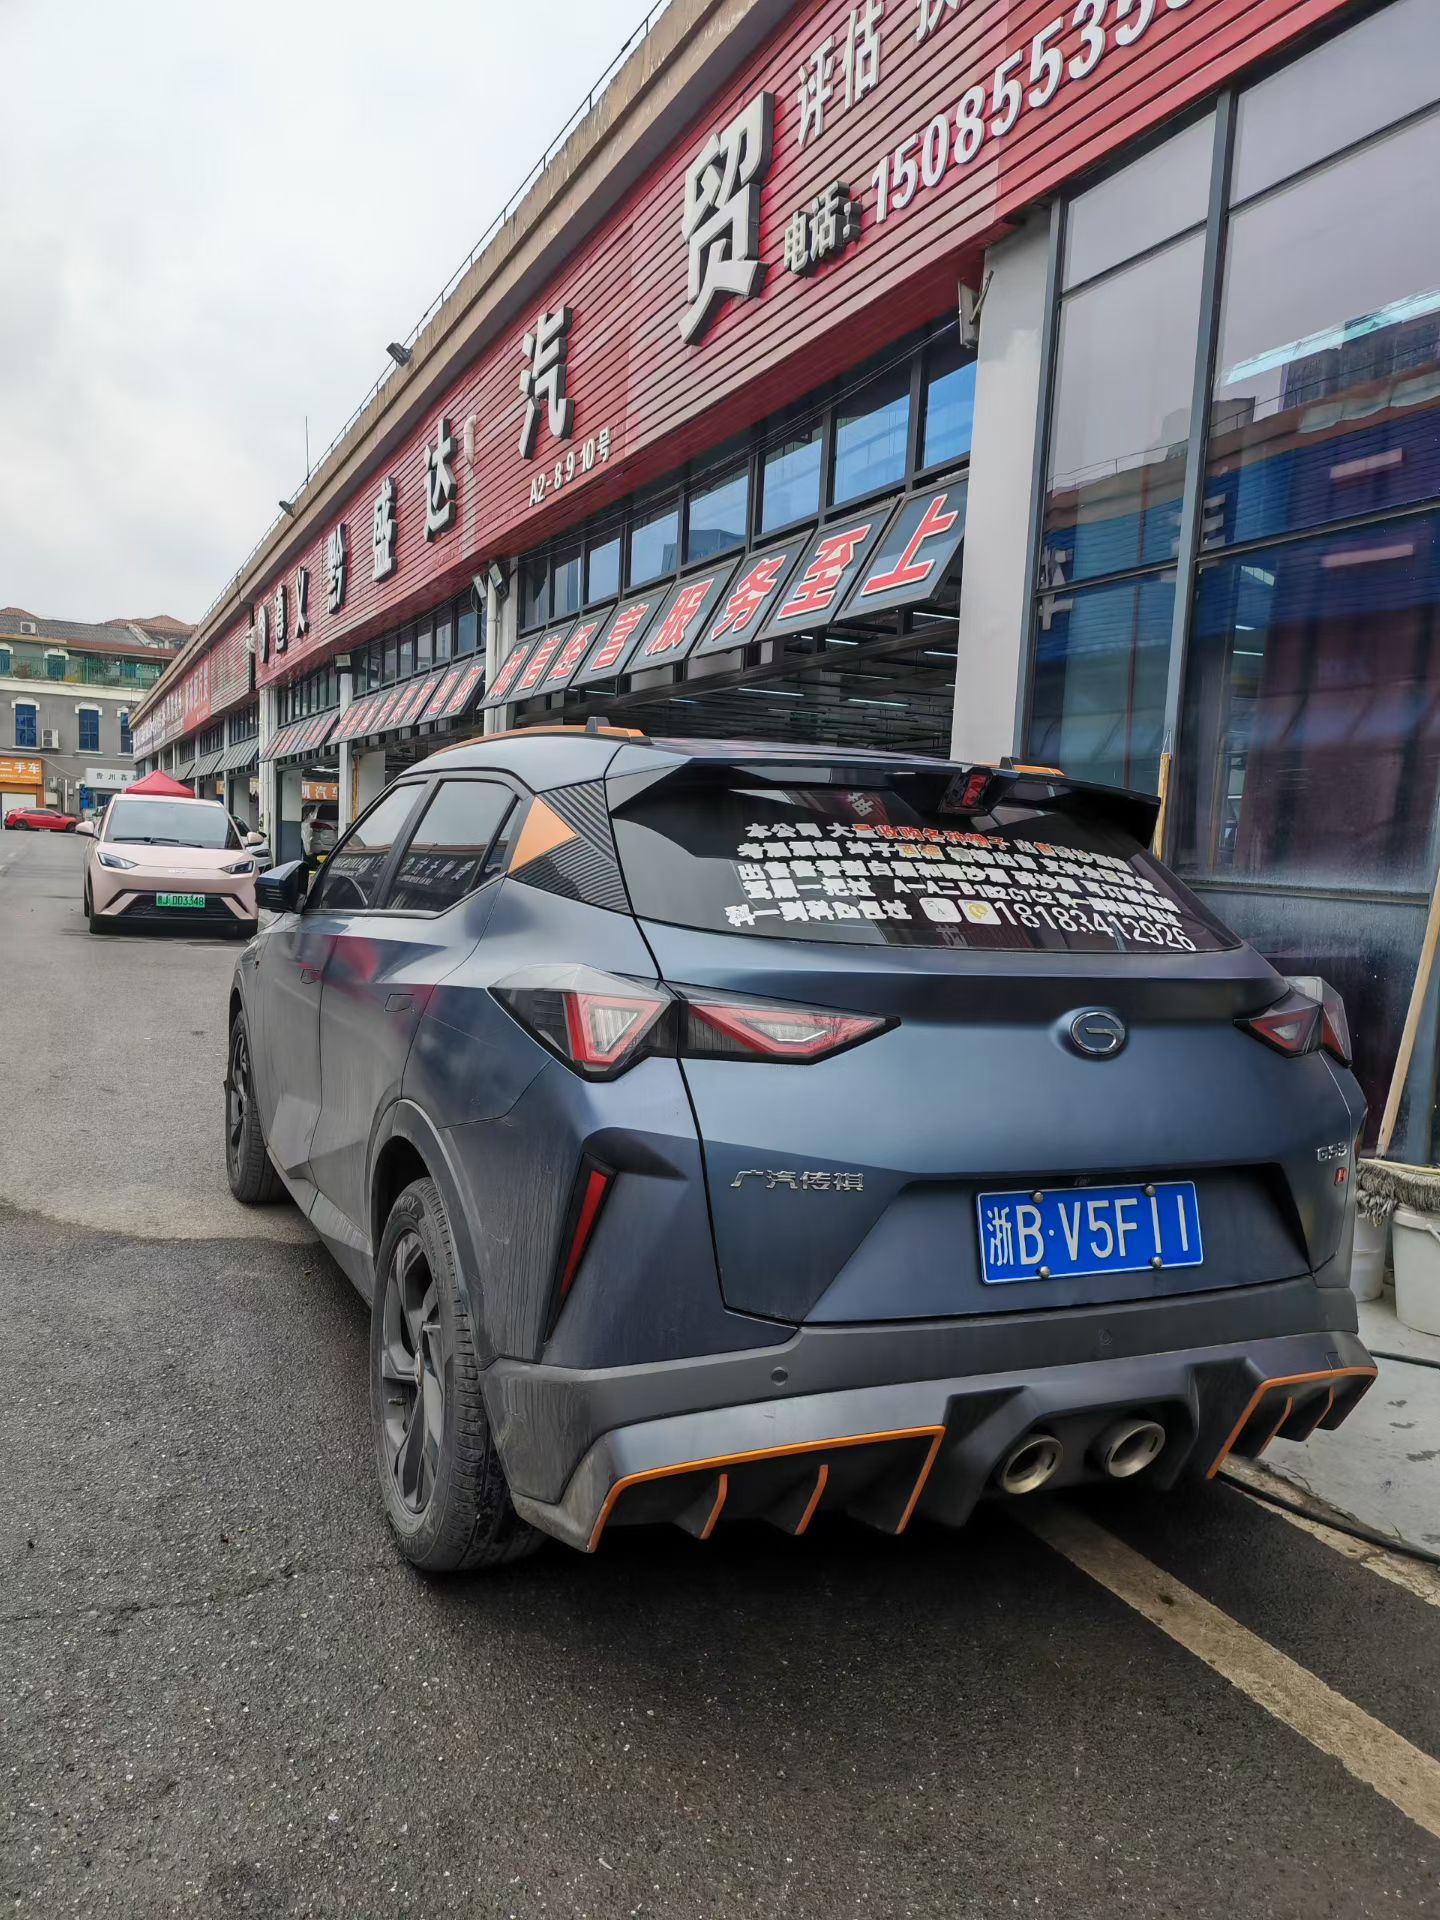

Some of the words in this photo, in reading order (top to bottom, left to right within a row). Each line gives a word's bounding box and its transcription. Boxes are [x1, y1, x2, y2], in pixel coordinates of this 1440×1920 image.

[798, 0, 884, 148] 评估
[872, 0, 1193, 224] 15085535
[995, 901, 1197, 951] 18183412926
[730, 1169, 864, 1191] 广汽传祺
